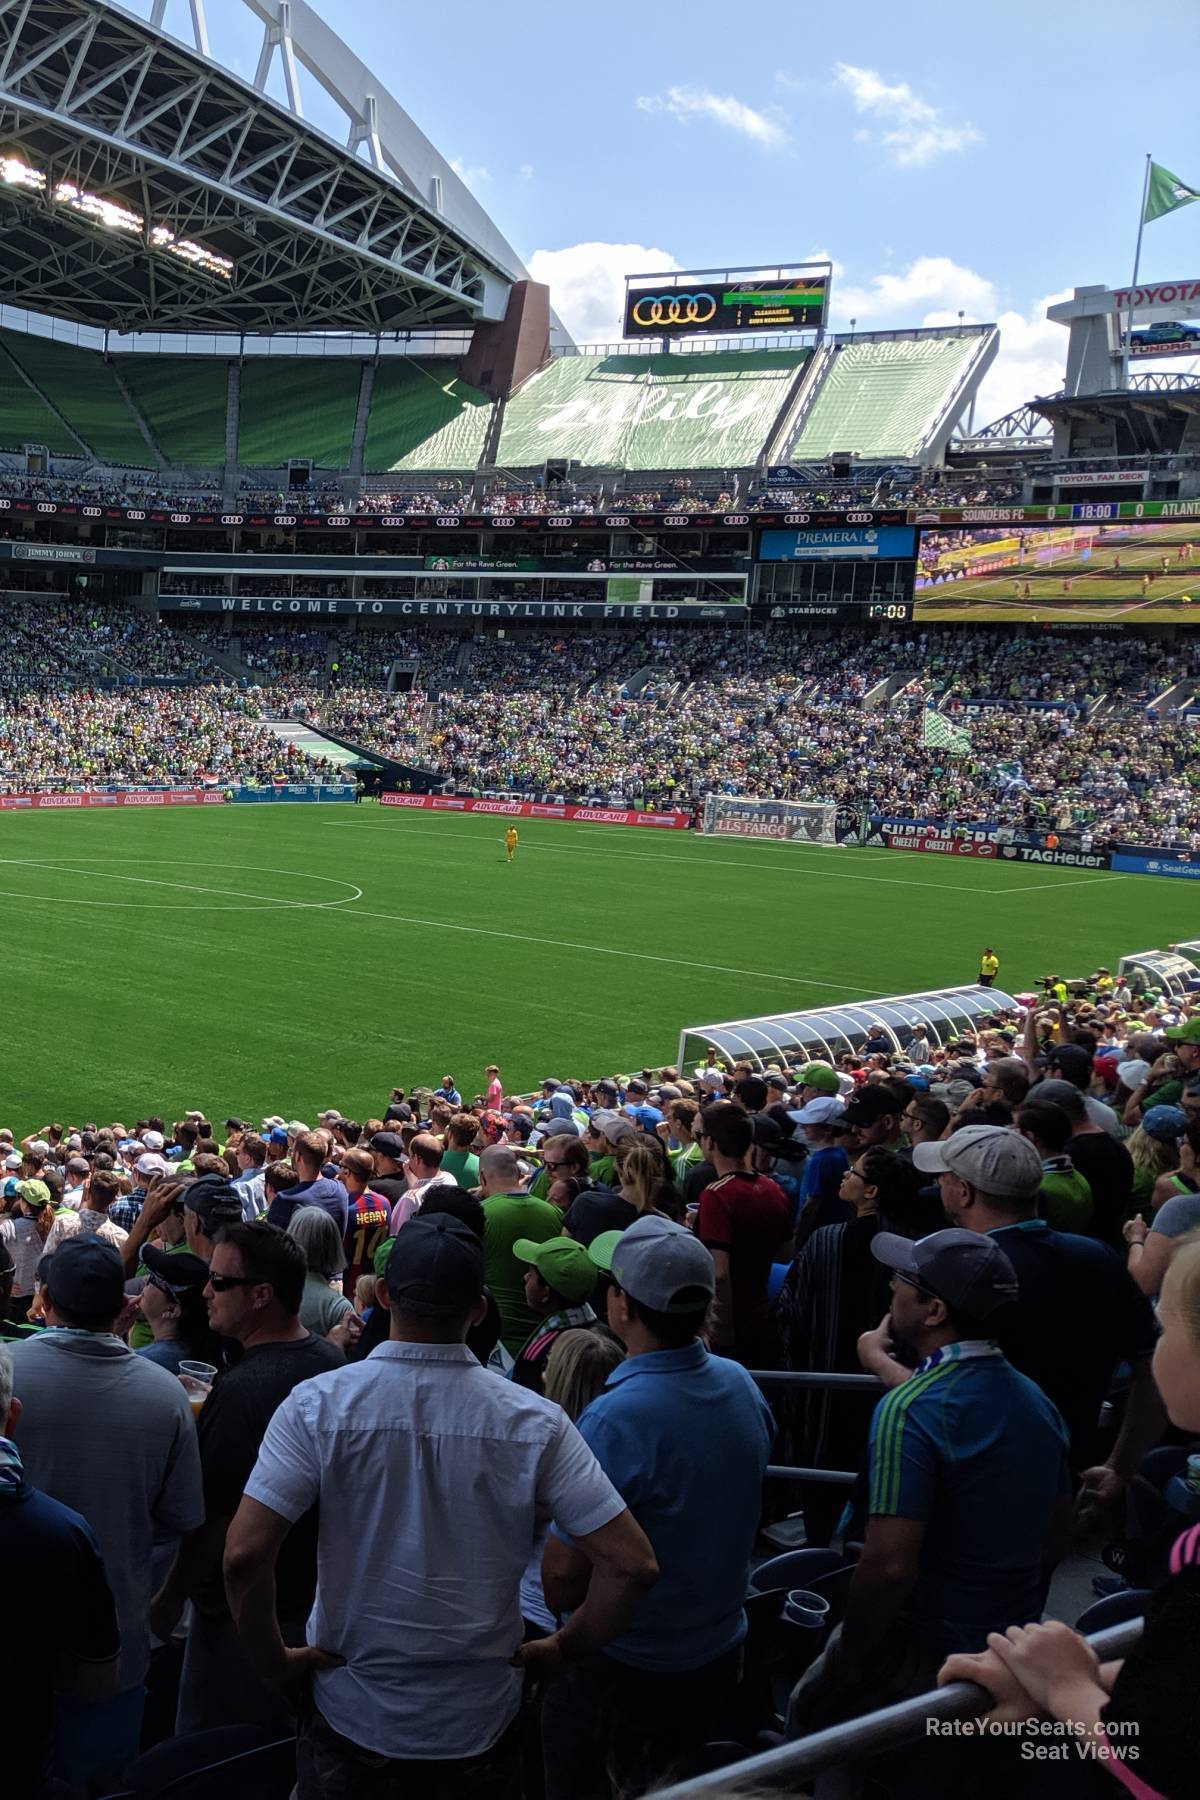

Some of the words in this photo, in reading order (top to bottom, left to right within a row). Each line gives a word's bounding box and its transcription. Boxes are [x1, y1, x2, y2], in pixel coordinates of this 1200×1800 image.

[1113, 283, 1200, 308] TOYOTA
[1130, 342, 1192, 354] TUNDRA
[537, 381, 762, 432] zulily
[1059, 475, 1096, 483] TOYOTA
[962, 508, 1011, 521] SOUNDERS
[1013, 508, 1024, 519] FC
[1047, 507, 1055, 520] 0
[1080, 505, 1112, 518] 18:00
[1135, 503, 1144, 517] 0
[1161, 502, 1200, 515] ATLANT
[797, 531, 858, 545] PREMERA
[27, 548, 54, 558] JIMMY
[55, 549, 81, 560] JOHN'S
[452, 560, 464, 568] For
[465, 560, 477, 568] the
[478, 560, 494, 568] Rave
[495, 560, 518, 568] Green.
[609, 561, 620, 569] For
[622, 561, 634, 569] the
[635, 561, 652, 569] Rave
[654, 561, 678, 569] Green.
[221, 599, 338, 612] WELCOME
[356, 601, 383, 613] TO
[402, 603, 585, 617] CENTURYLINK
[604, 605, 679, 618] FIELD
[39, 796, 82, 806] ADVOCARE
[124, 794, 164, 804] ADVOCARE
[381, 793, 426, 807] ADVOCARE
[472, 801, 523, 814] ADVOCARE
[573, 809, 630, 823] ADVOCARE
[745, 823, 788, 836] FARGO
[356, 1210, 387, 1225] HENRY
